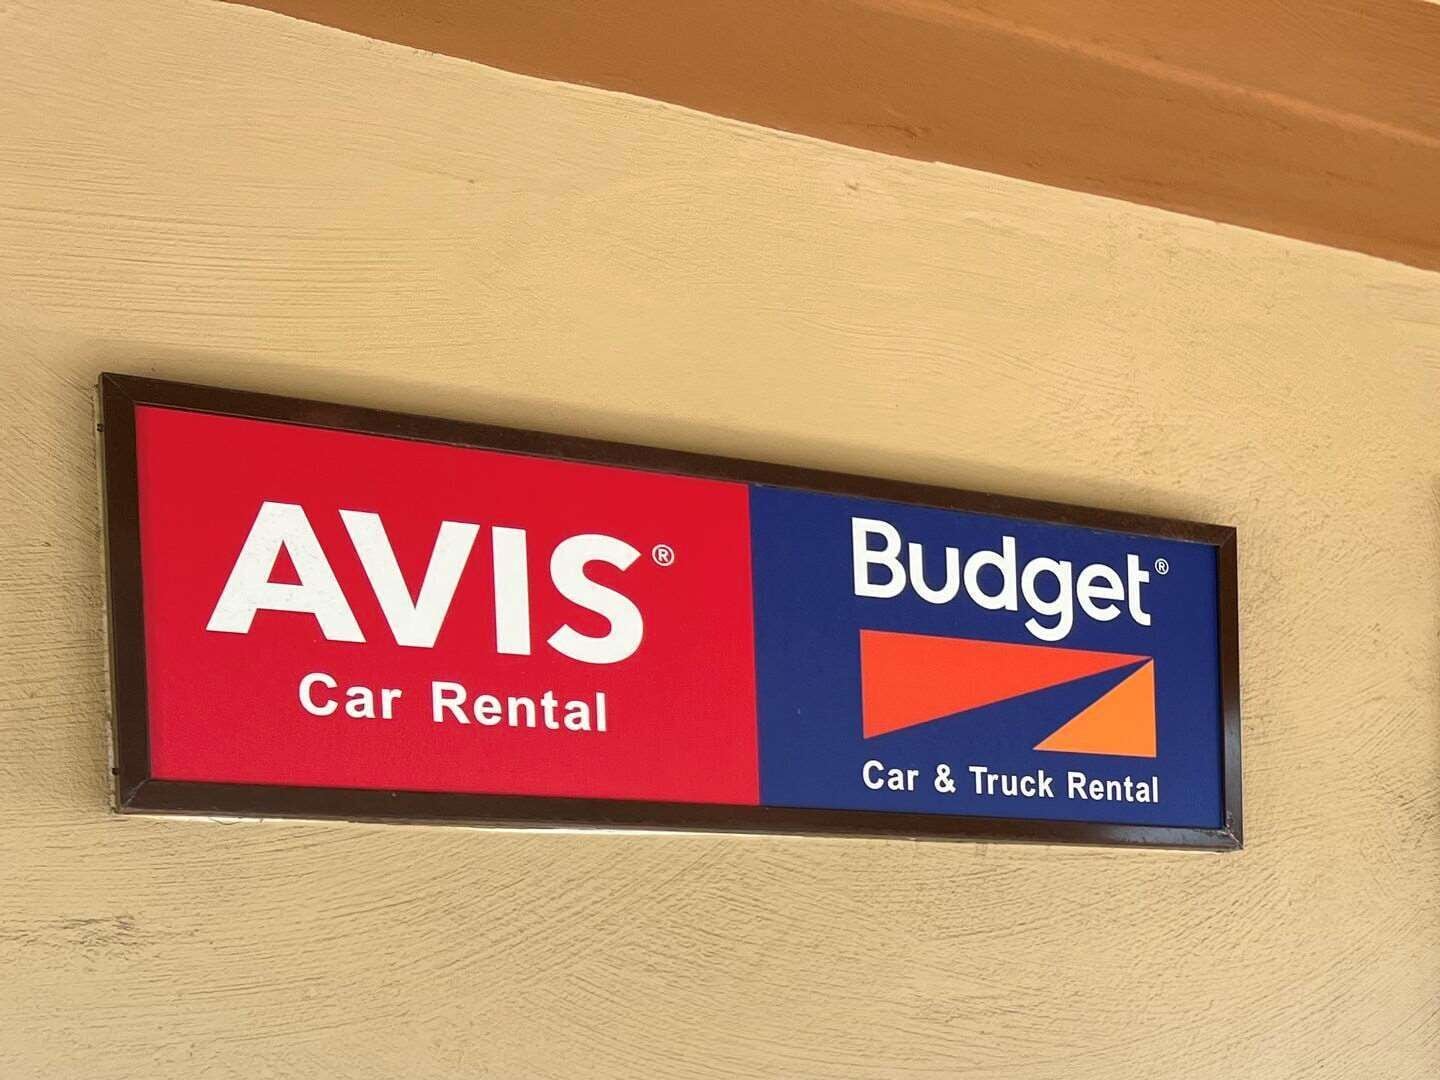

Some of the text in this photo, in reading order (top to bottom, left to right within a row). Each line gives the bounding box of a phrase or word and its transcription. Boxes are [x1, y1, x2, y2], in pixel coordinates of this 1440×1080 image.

[299, 672, 607, 732] Car Rental
[862, 759, 1159, 803] Car & Truck Rental
